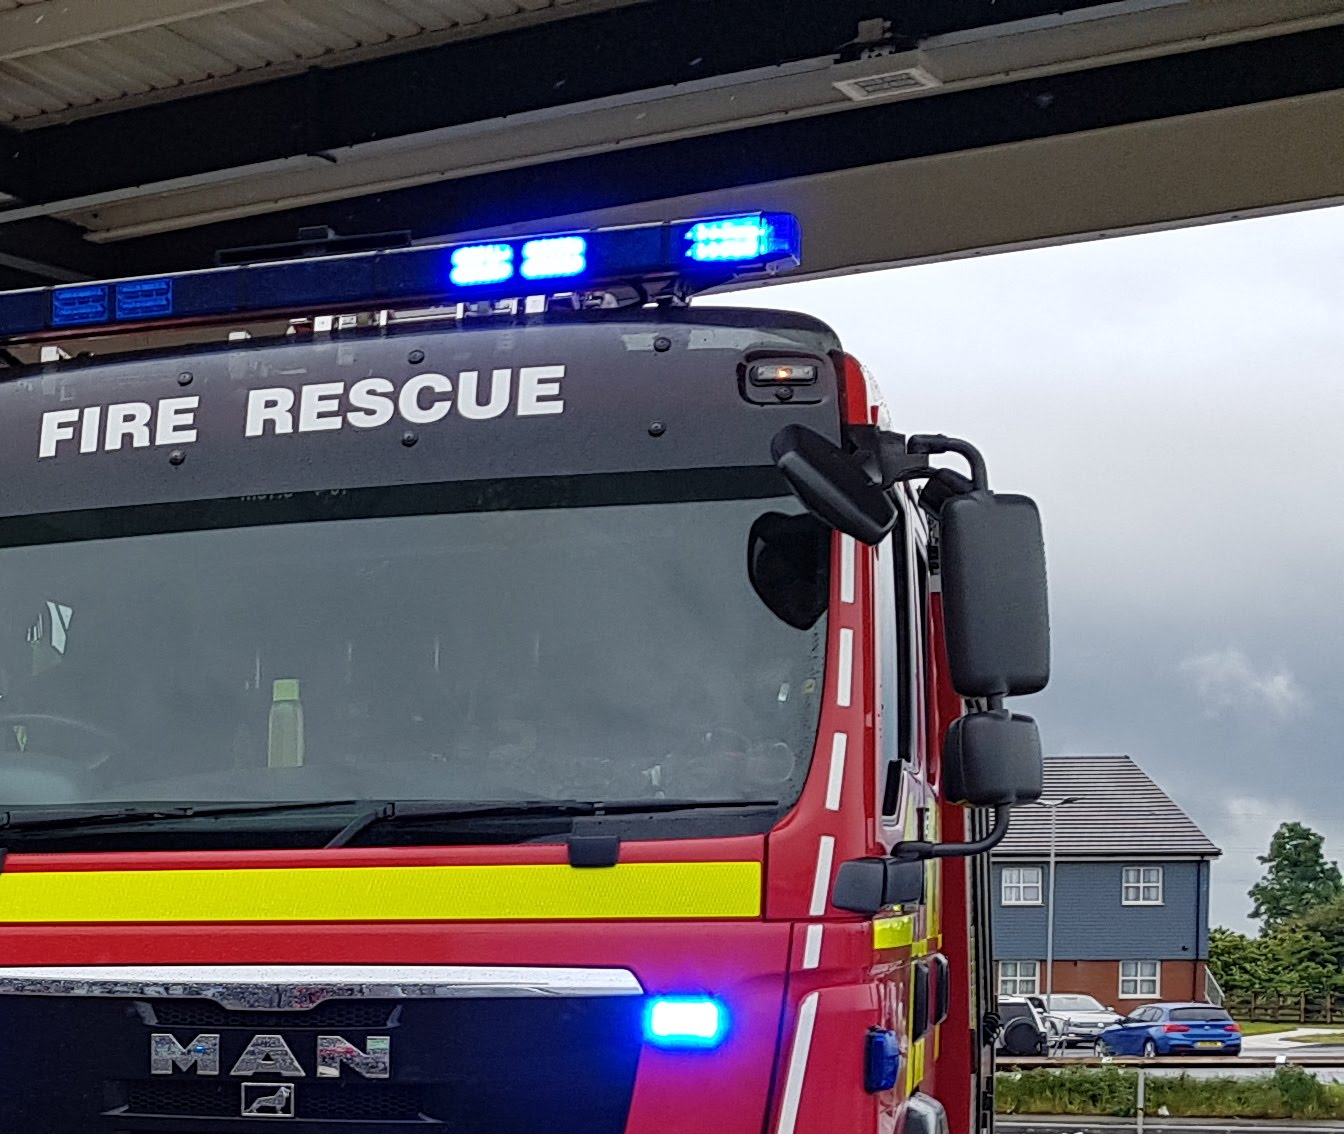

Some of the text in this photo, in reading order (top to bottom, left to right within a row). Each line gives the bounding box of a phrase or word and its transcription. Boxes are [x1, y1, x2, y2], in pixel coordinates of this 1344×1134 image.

[38, 365, 566, 459] FIRE RESCUE
[151, 1033, 390, 1079] MAN
